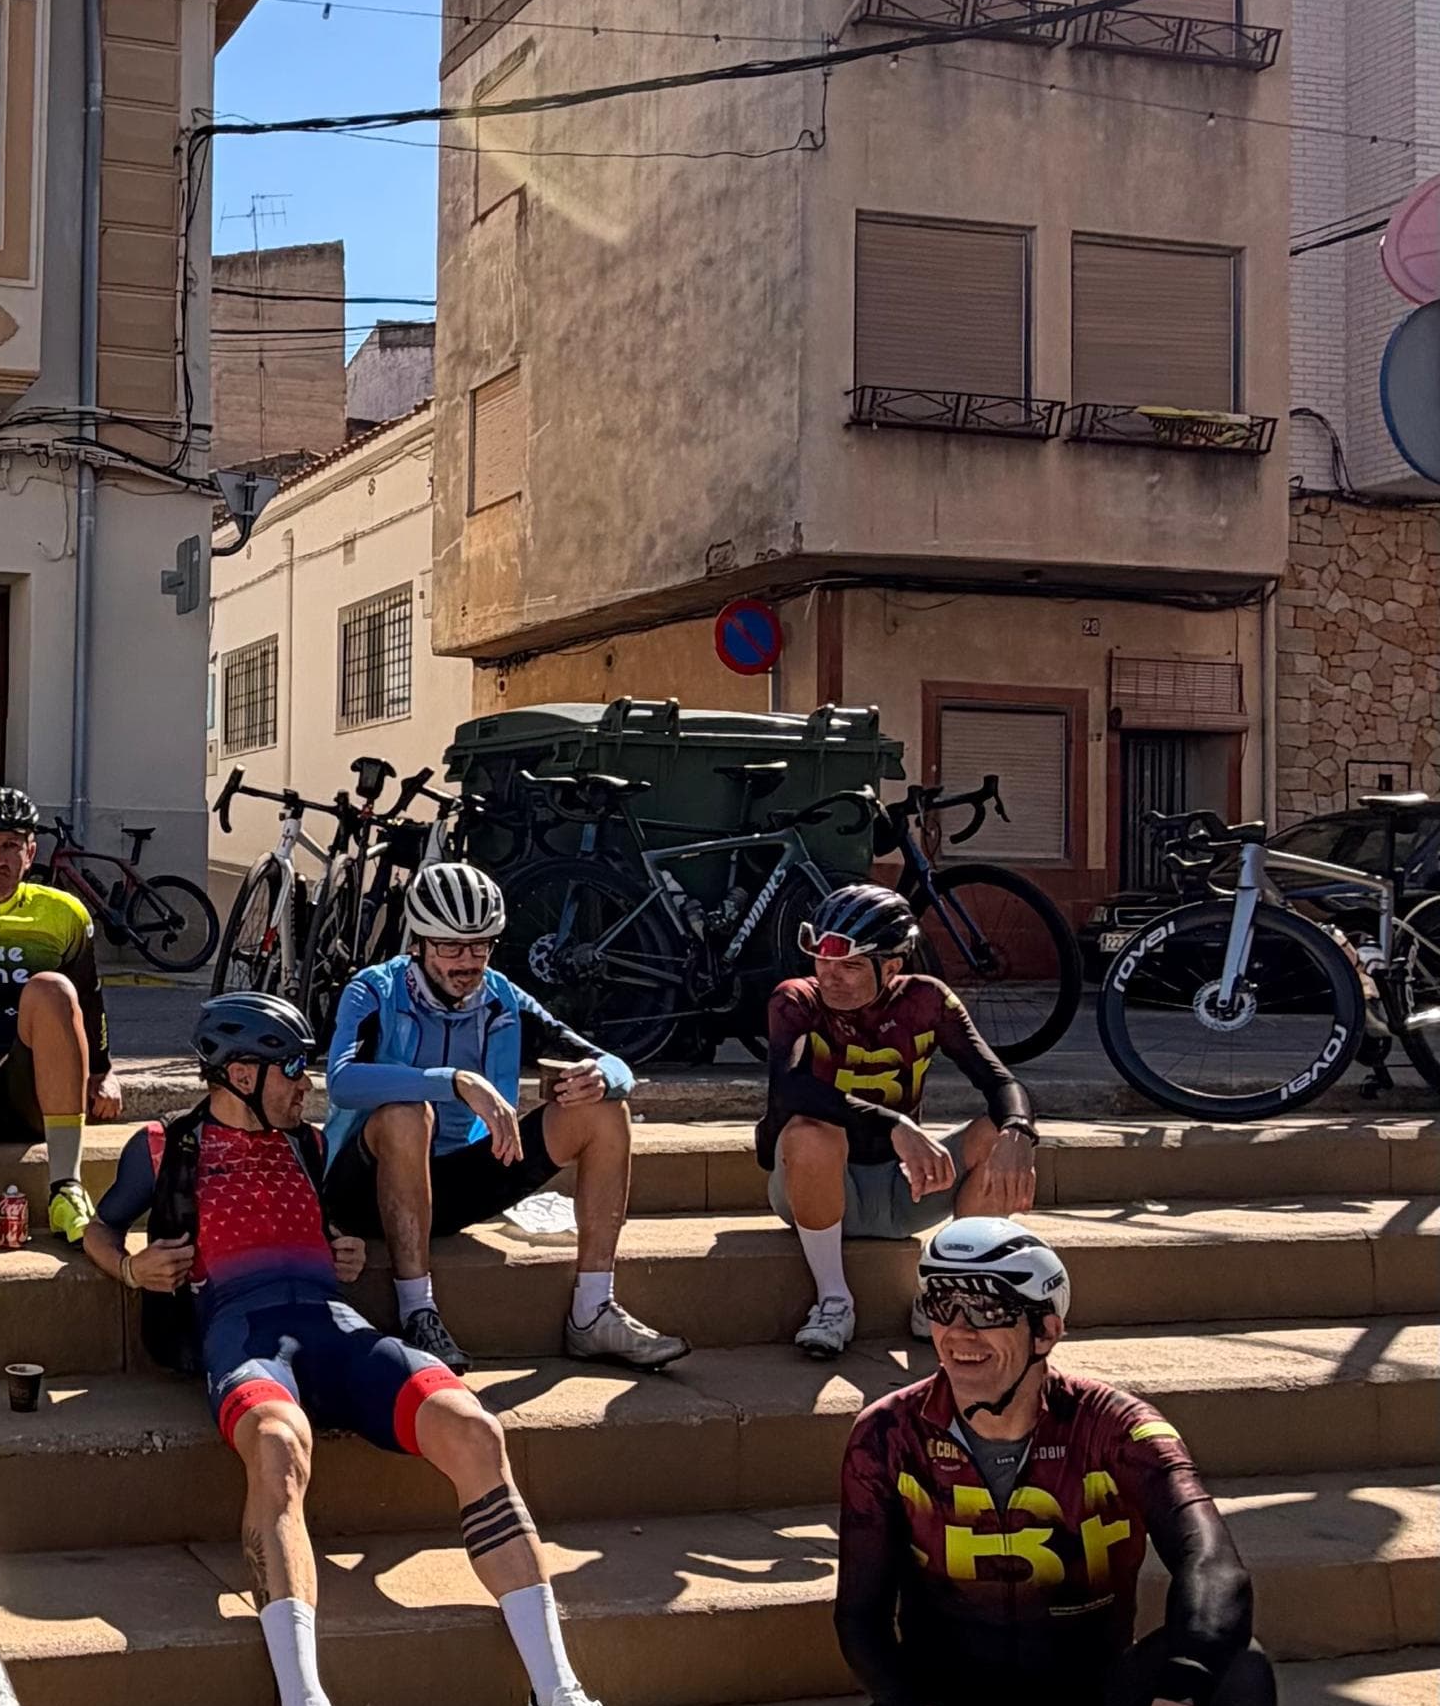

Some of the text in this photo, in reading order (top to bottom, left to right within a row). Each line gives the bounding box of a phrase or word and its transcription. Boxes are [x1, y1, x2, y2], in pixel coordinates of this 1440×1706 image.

[728, 862, 787, 959] S-WORKS
[1112, 920, 1176, 993] roval
[1280, 1023, 1347, 1102] roval
